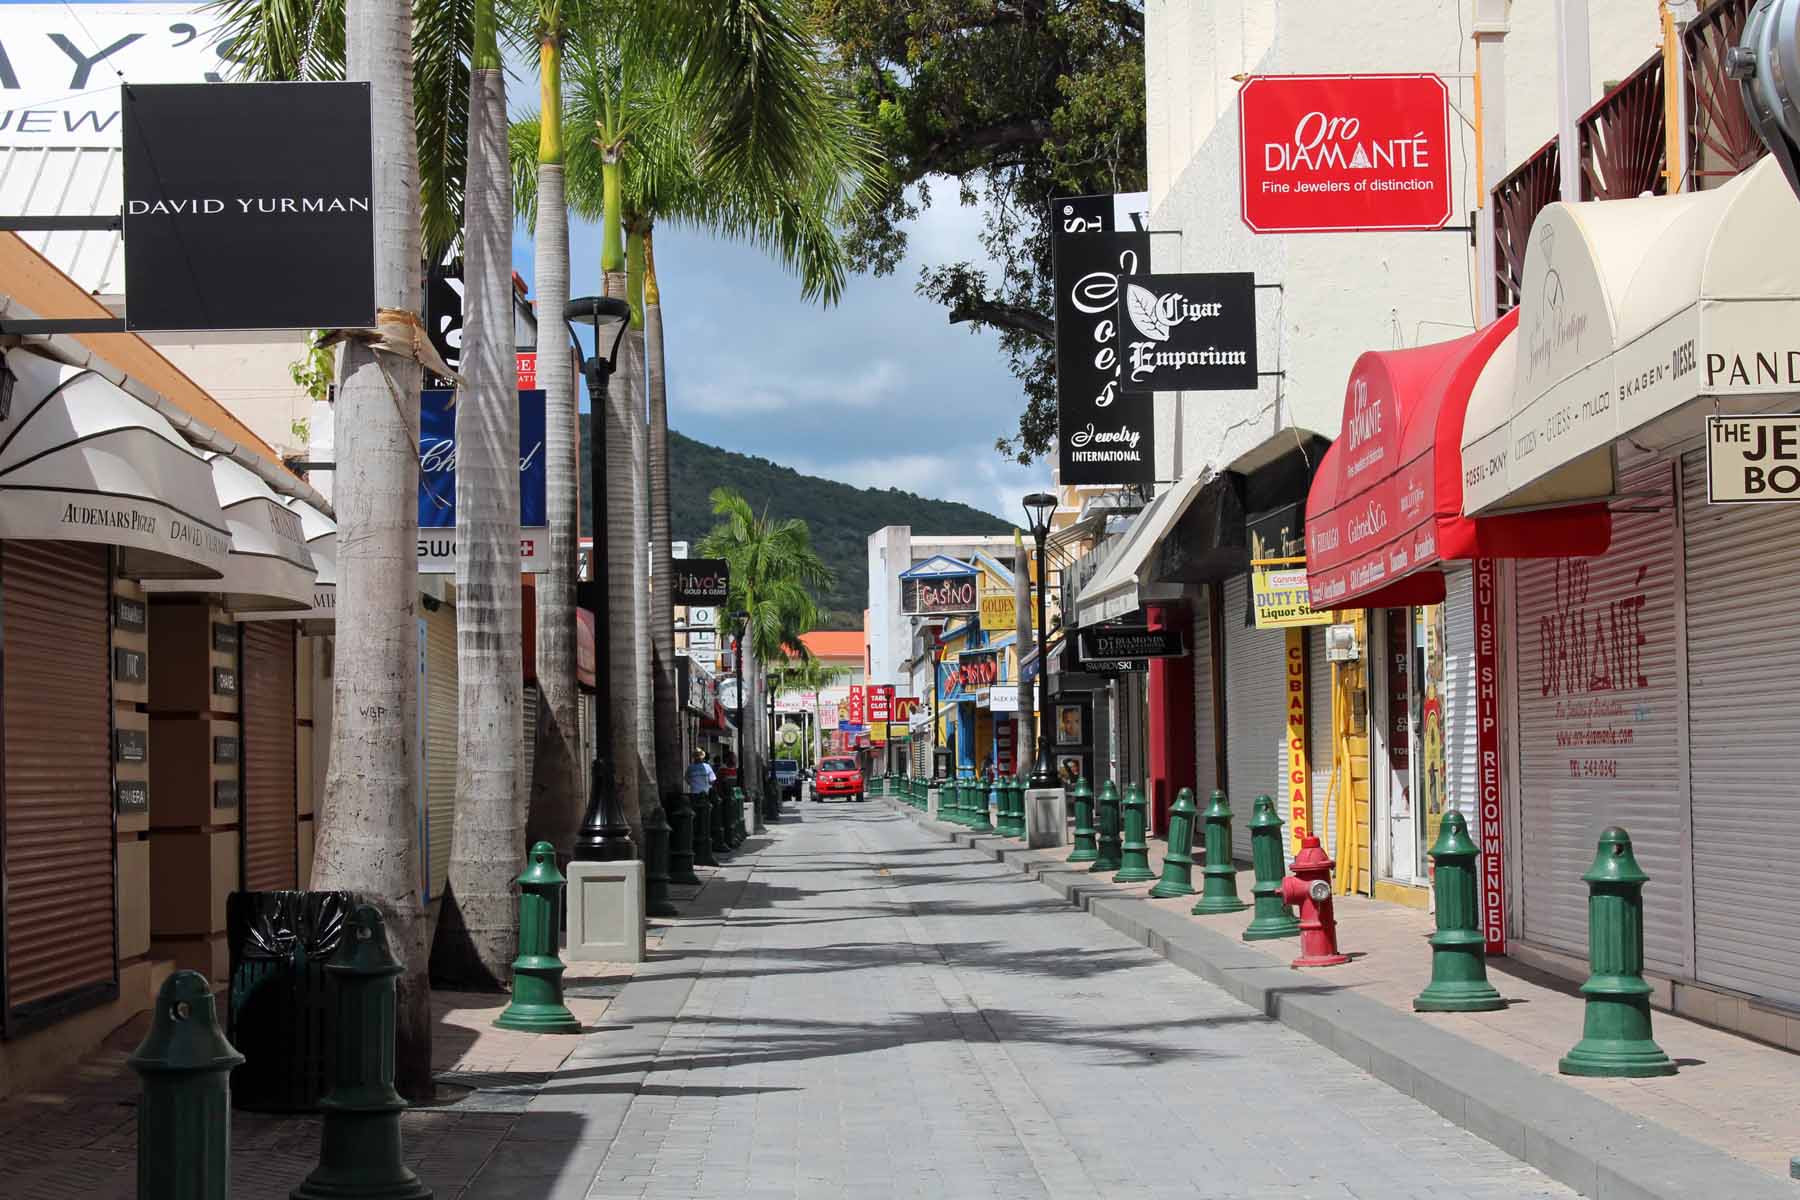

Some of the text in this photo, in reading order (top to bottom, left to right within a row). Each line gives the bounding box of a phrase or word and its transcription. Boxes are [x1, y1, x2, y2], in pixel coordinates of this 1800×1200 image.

[1294, 111, 1360, 150] Oro
[1264, 131, 1429, 171] DIAMANTÉ
[1262, 178, 1434, 193] Fine Jewelers of distinction
[129, 197, 369, 215] DAVID YURMAN
[1155, 292, 1222, 327] Cigar
[1128, 341, 1246, 382] Emporium
[1489, 449, 1508, 478] DKNY
[1619, 372, 1663, 401] SKAGEN
[1672, 339, 1697, 381] DIESEL
[1071, 423, 1141, 449] Jewelry
[1713, 424, 1751, 443] THE
[1072, 450, 1141, 462] INTERNATIONAL
[61, 503, 130, 529] AUDEMARS
[170, 520, 203, 546] DAVID
[922, 583, 972, 606] CASINO
[982, 599, 1013, 613] GOLDEN
[1257, 591, 1292, 607] DUTY
[1261, 607, 1296, 620] Liquor
[1086, 661, 1132, 671] SWAROVSKI
[1288, 647, 1306, 841] CUBAN CIGARS
[1477, 558, 1501, 943] CRUISE SHIP RECOMMENDED
